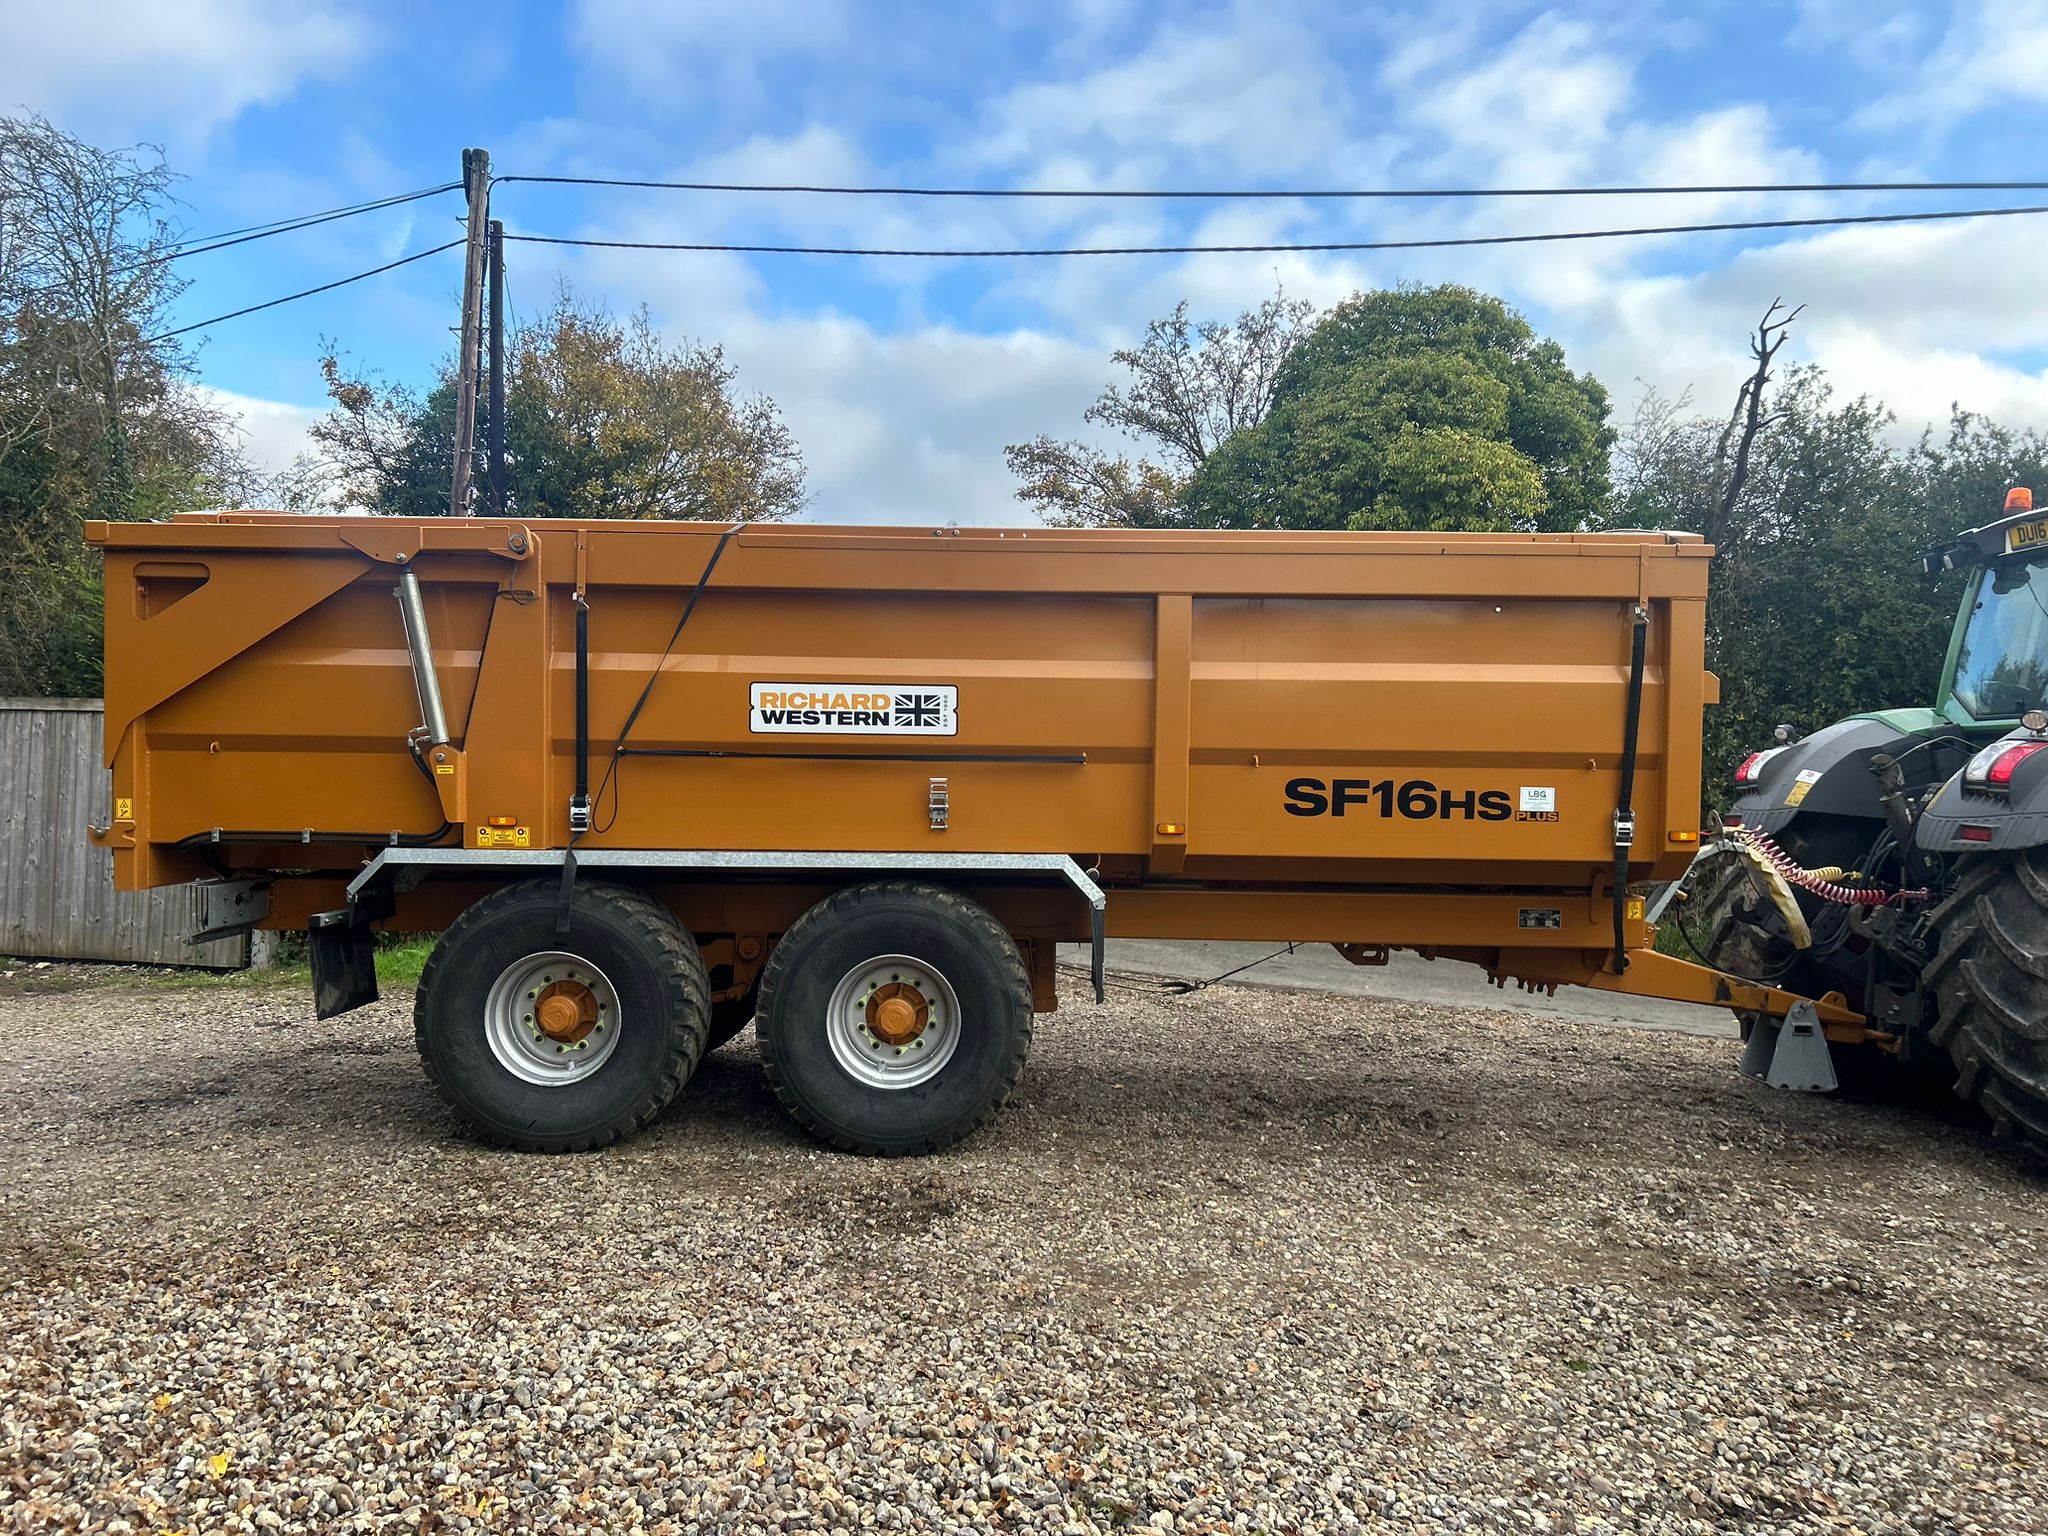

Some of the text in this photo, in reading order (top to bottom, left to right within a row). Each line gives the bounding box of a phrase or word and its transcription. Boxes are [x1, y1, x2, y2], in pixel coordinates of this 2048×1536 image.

[2017, 523, 2047, 543] DU16
[759, 692, 891, 710] RICHARD
[760, 710, 890, 726] WESTERN
[1283, 777, 1512, 821] SF16HS
[1515, 811, 1558, 821] PLUS
